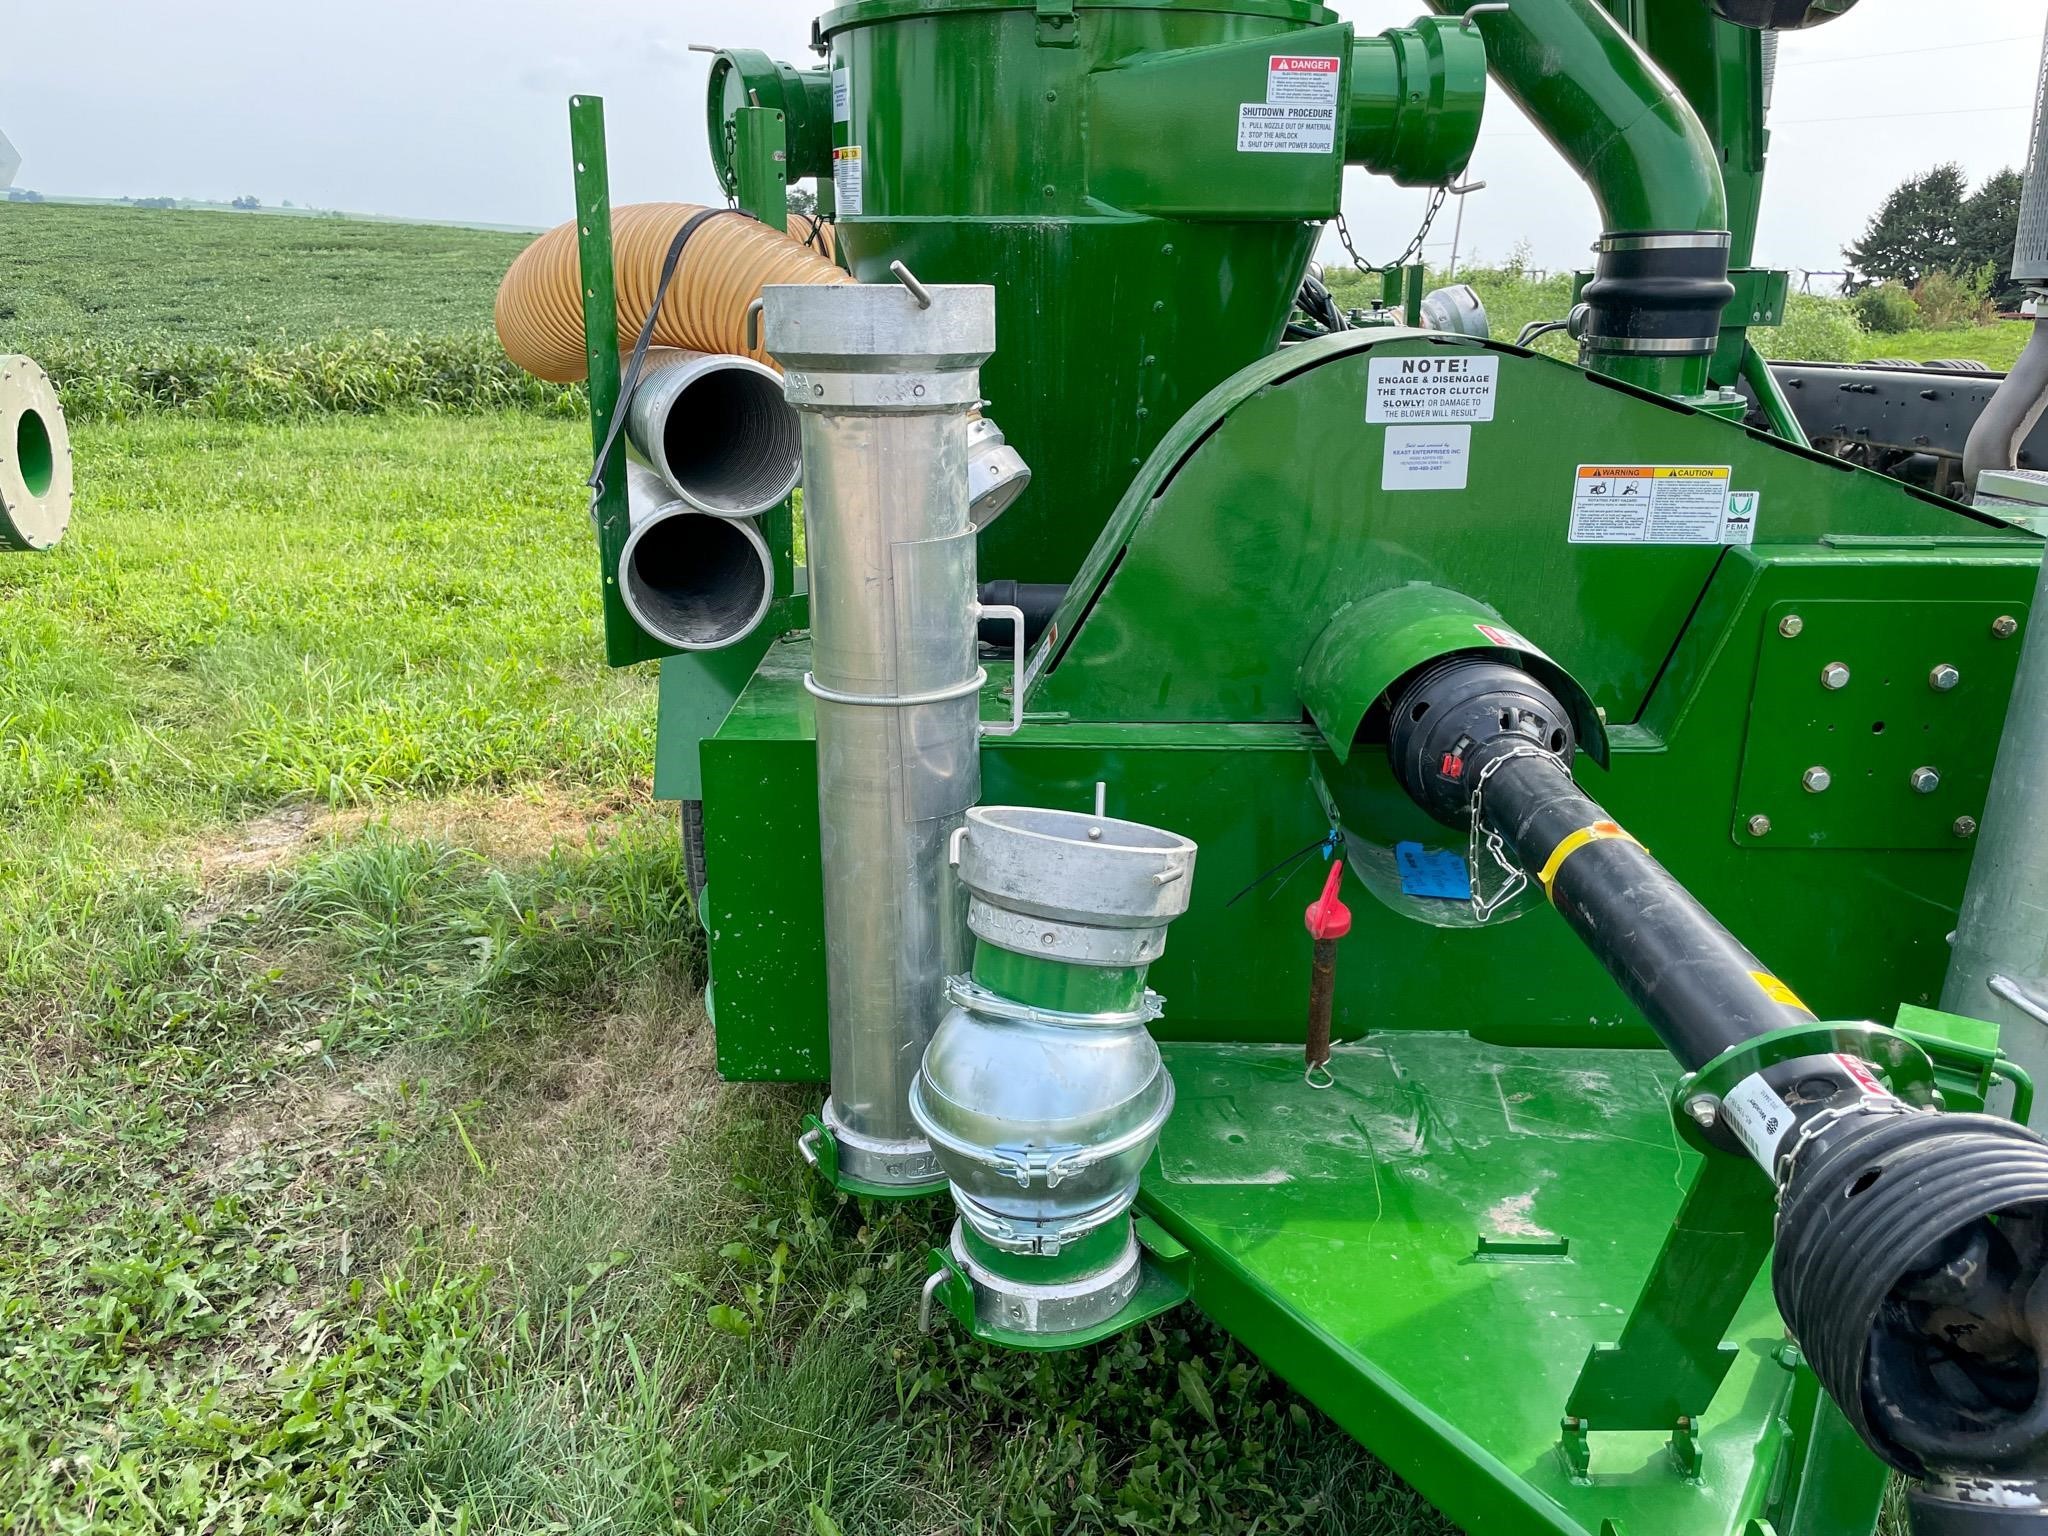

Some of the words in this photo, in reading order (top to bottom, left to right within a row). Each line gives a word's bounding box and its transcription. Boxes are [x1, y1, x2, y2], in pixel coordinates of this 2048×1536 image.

[1291, 60, 1331, 70] DANGER
[1242, 107, 1284, 117] SHUTDOWN
[1288, 108, 1333, 118] PROCEDURE
[1264, 122, 1285, 130] NOZZLE
[1306, 123, 1332, 131] MATERIAL
[1309, 142, 1331, 150] SOURCE
[1402, 359, 1469, 374] NOTE!
[1378, 376, 1419, 384] ENGAGE
[1432, 375, 1490, 383] DISENGAGE
[1377, 388, 1396, 396] THE
[1400, 387, 1446, 395] TRACTOR
[1449, 387, 1489, 395] CLUTCH
[1382, 400, 1425, 408] SLOWLY!
[1428, 399, 1438, 407] OR
[1440, 399, 1470, 407] DAMAGE
[1472, 398, 1481, 406] TO
[1385, 410, 1398, 418] THE
[1400, 410, 1431, 418] BLOWER
[1432, 409, 1448, 417] WILL
[1450, 409, 1478, 417] RESULT
[1602, 469, 1640, 477] WARNING
[1678, 469, 1714, 477] CAUTION
[1726, 523, 1749, 531] FEMA
